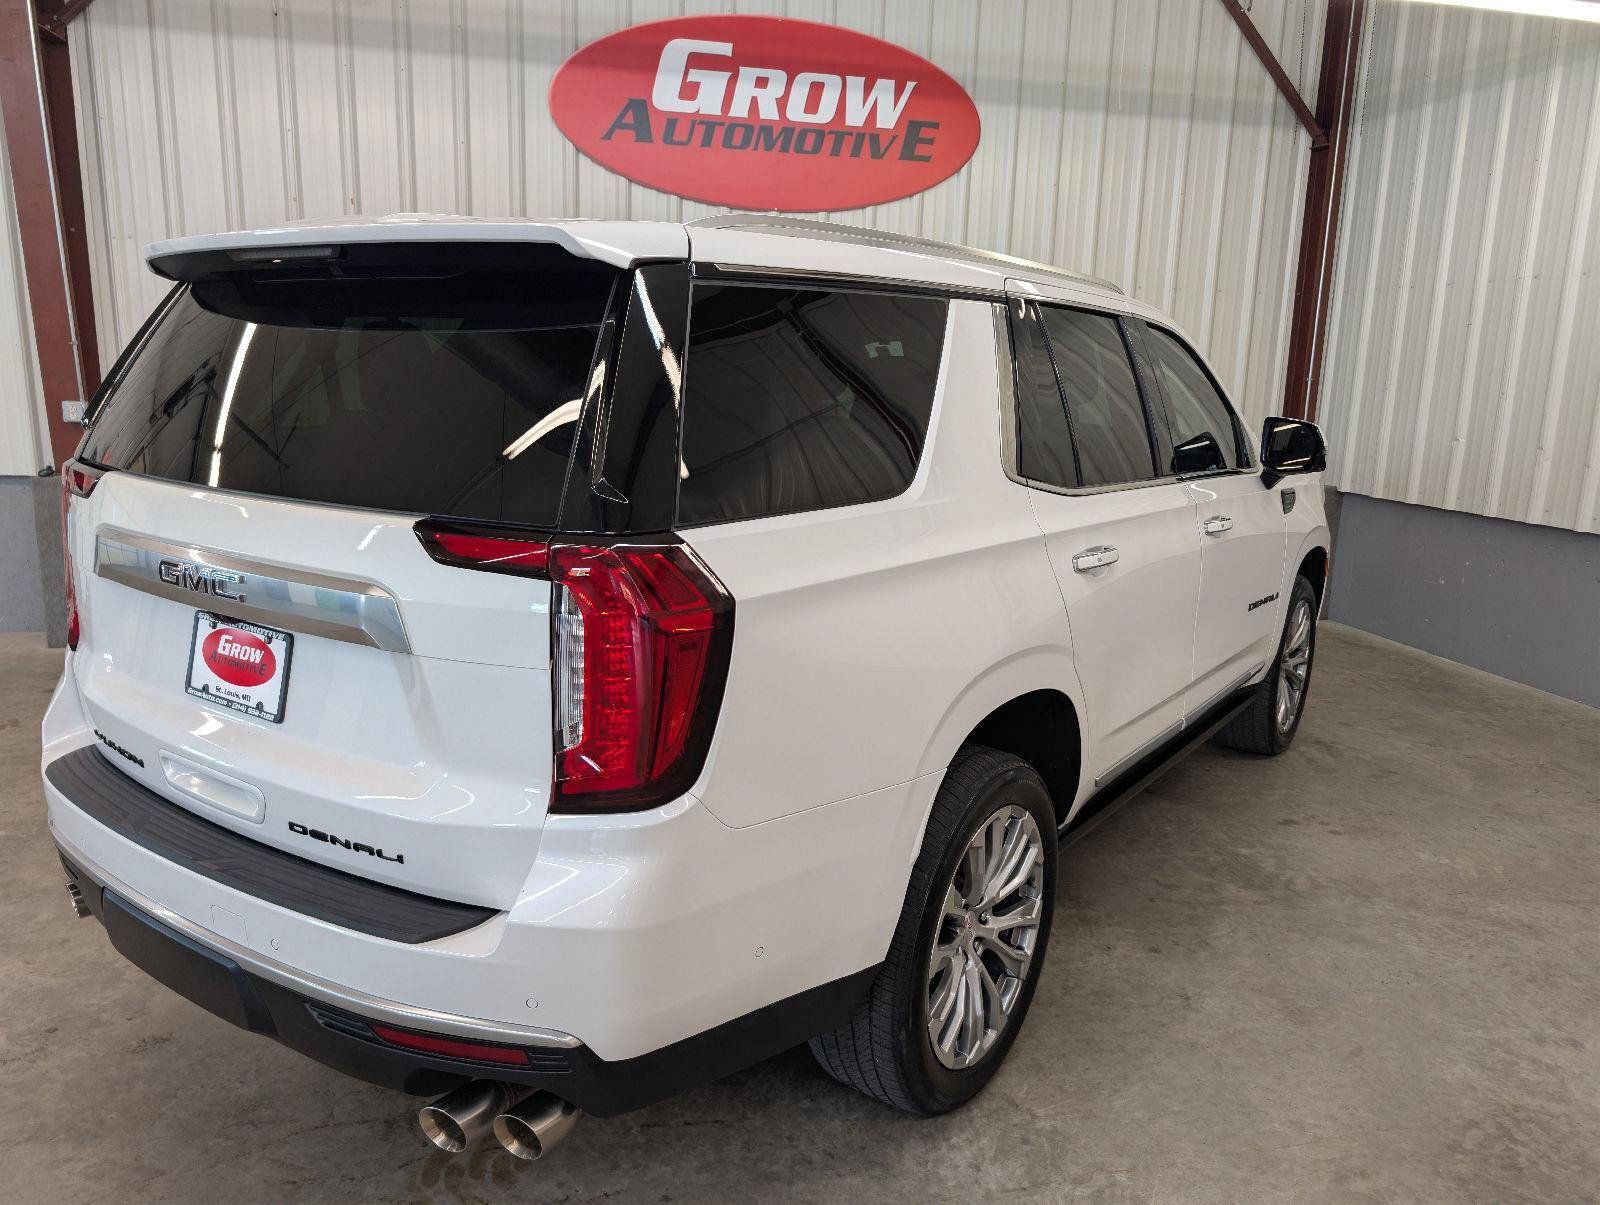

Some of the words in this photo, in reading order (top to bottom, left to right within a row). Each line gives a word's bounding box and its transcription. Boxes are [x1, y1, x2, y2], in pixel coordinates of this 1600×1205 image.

[651, 38, 918, 130] GROW
[600, 97, 940, 162] AUTOMOTIVE
[159, 560, 247, 602] GMC
[1248, 592, 1279, 612] DENALI
[218, 634, 264, 663] GROW
[287, 821, 405, 864] DENALI
